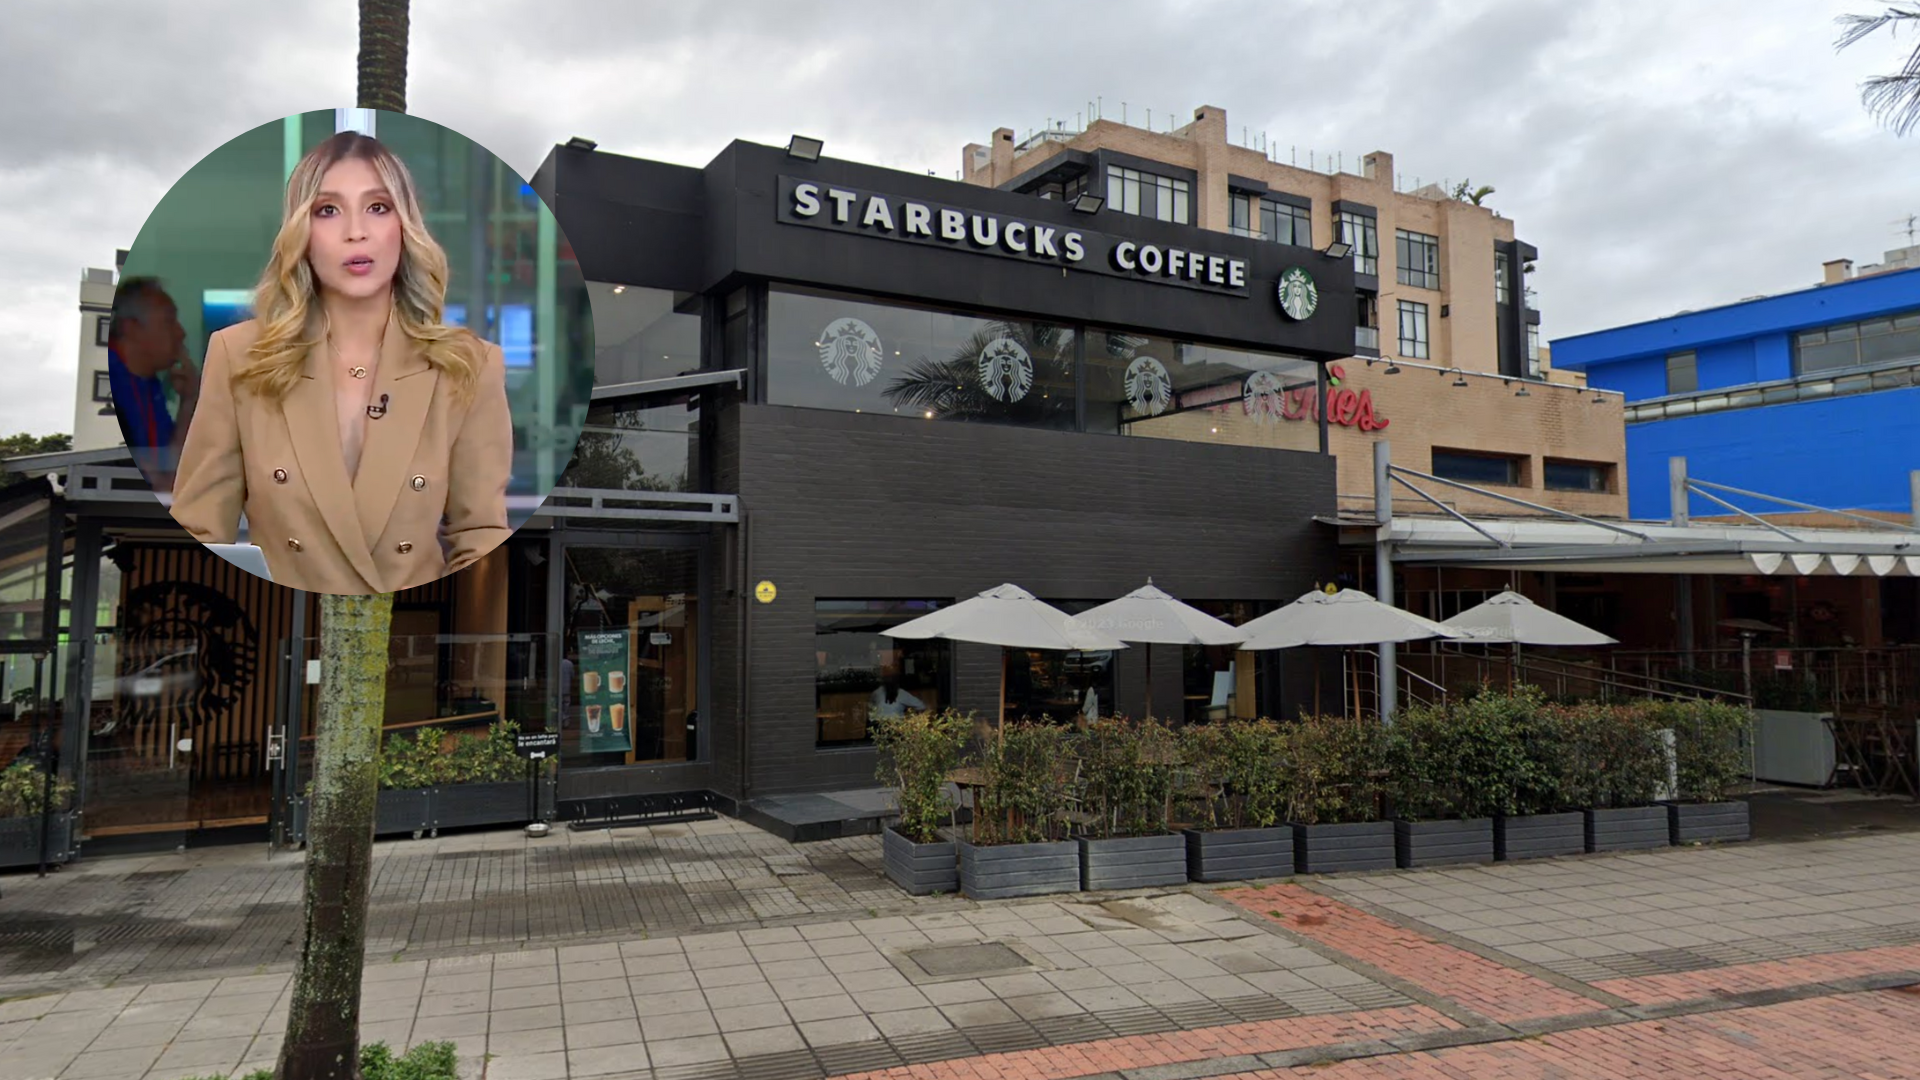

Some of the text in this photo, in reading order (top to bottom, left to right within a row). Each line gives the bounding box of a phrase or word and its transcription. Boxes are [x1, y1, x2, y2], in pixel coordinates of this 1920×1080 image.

[794, 183, 1245, 287] STARBUCKS COFFEE
[525, 738, 556, 746] encantará
